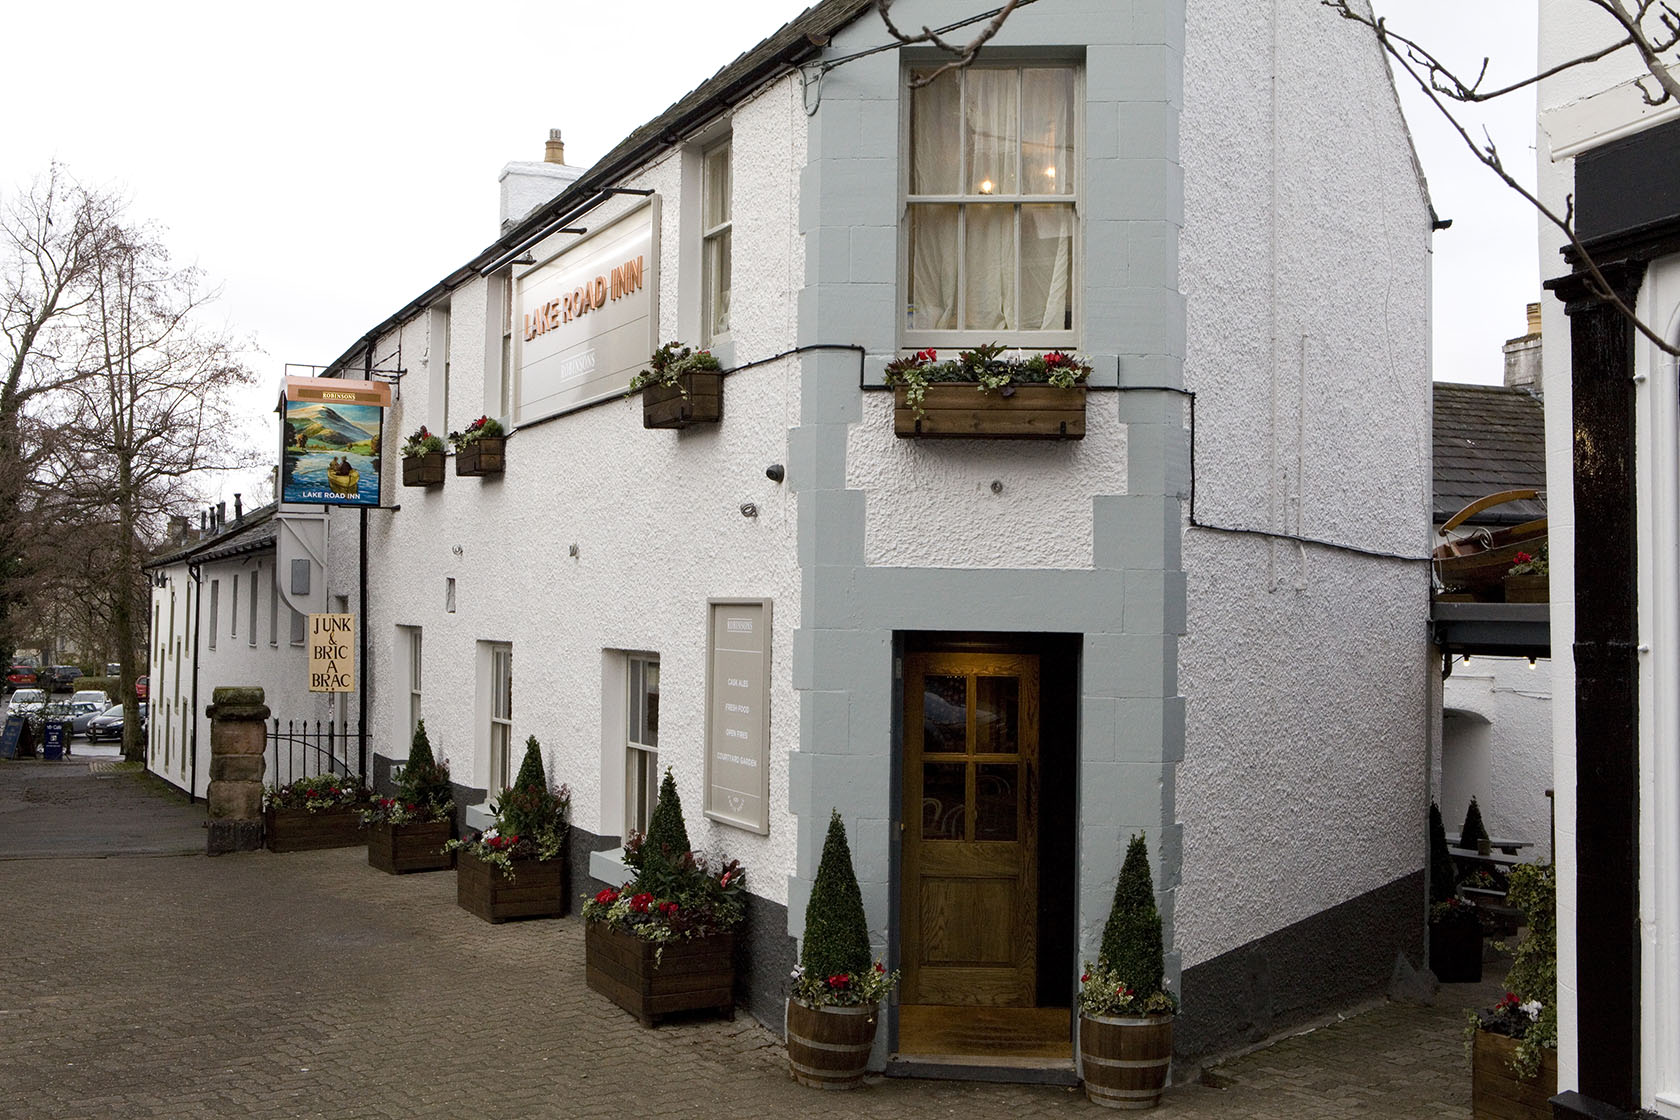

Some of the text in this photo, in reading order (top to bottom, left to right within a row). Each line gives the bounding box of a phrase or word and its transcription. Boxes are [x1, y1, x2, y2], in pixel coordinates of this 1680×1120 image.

[524, 255, 643, 342] LAKE ROAD INN
[322, 391, 356, 400] ROBINSONS
[302, 491, 322, 499] LAKE
[313, 617, 351, 635] JUNK
[328, 631, 338, 646] &
[314, 645, 348, 660] BRIC
[326, 660, 338, 673] A
[312, 673, 351, 688] BRAC
